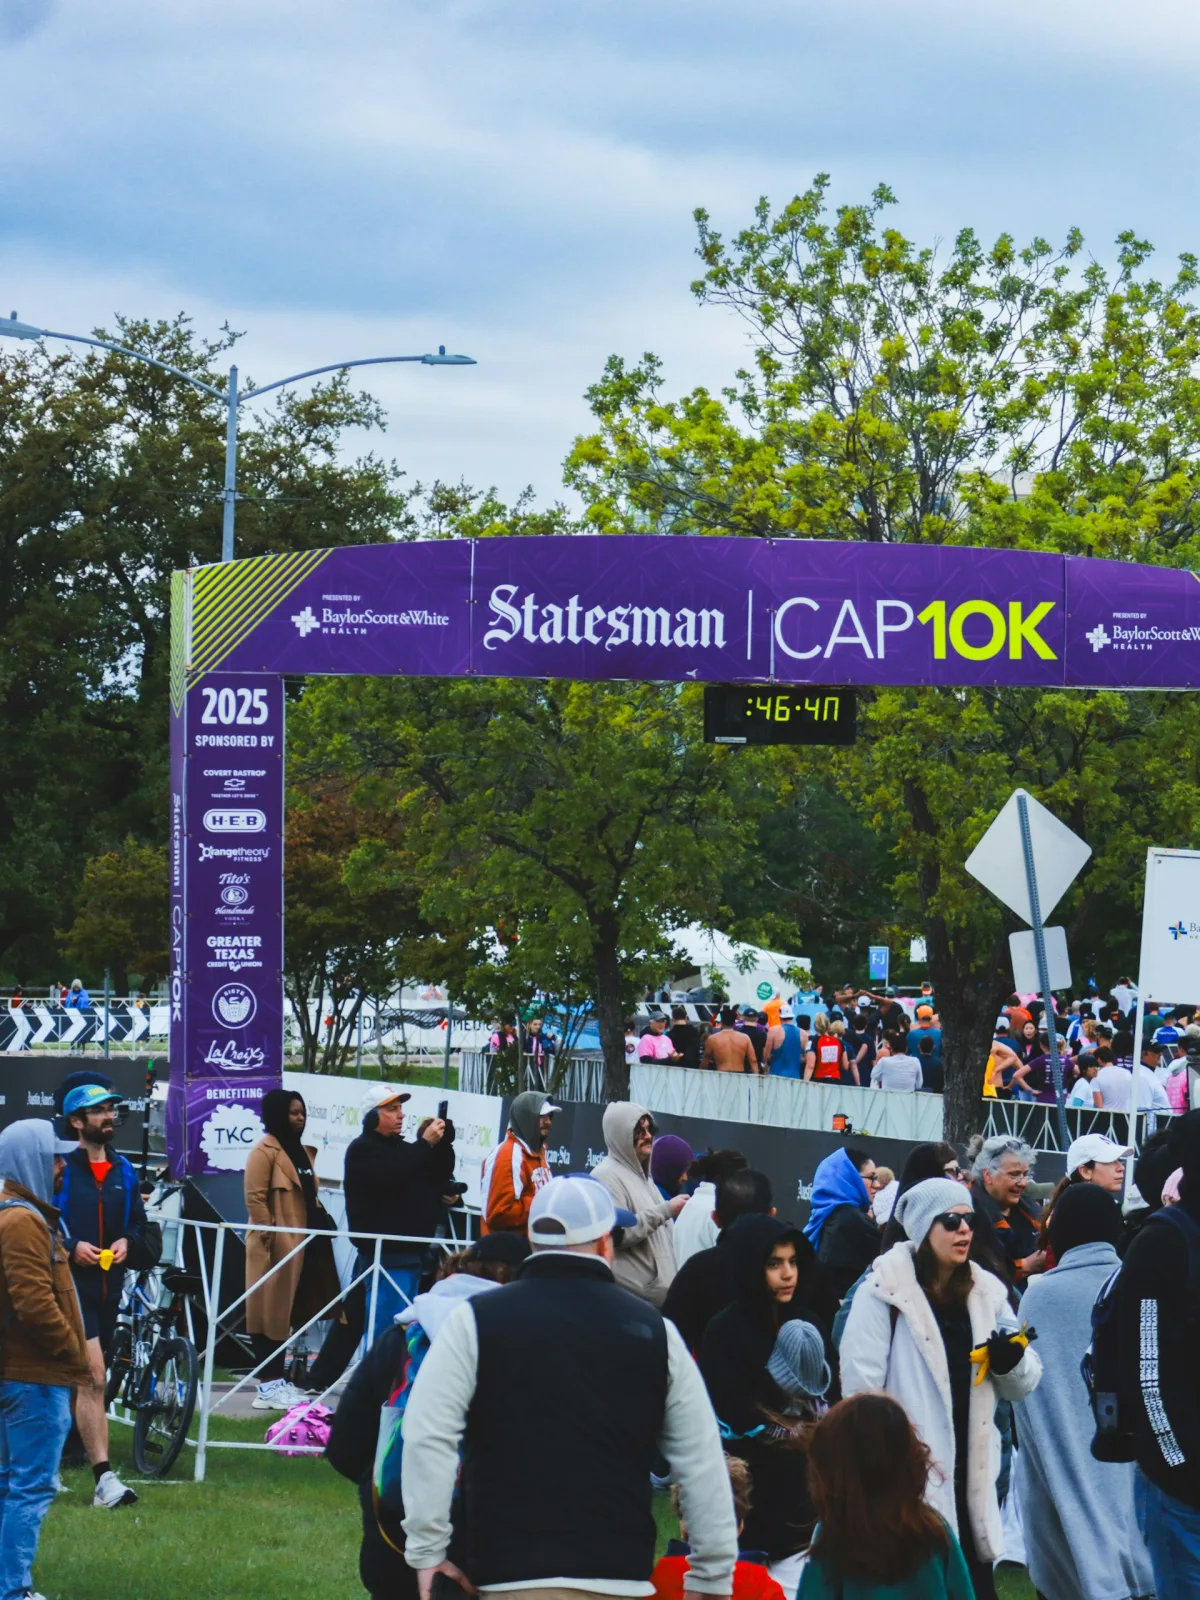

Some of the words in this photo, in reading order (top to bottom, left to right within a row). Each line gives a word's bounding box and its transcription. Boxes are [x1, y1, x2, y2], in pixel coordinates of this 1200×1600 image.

[322, 608, 449, 627] BaylorScott&White
[482, 583, 727, 652] Statesman
[773, 596, 1059, 661] CAP10K
[322, 627, 367, 635] HEALTH
[200, 687, 269, 726] 2025
[195, 735, 258, 747] SPONSORED
[260, 735, 275, 747] BY
[203, 769, 232, 777] COVERT
[233, 769, 267, 777] BASTROP
[172, 793, 181, 887] Statesman
[218, 872, 251, 885] Tito's
[206, 935, 262, 948] GREATER
[214, 948, 255, 960] TEXAS
[172, 905, 182, 1023] CAP10K
[223, 988, 246, 997] SIETE
[206, 1087, 263, 1100] BENEFITING
[214, 1126, 254, 1144] TKC
